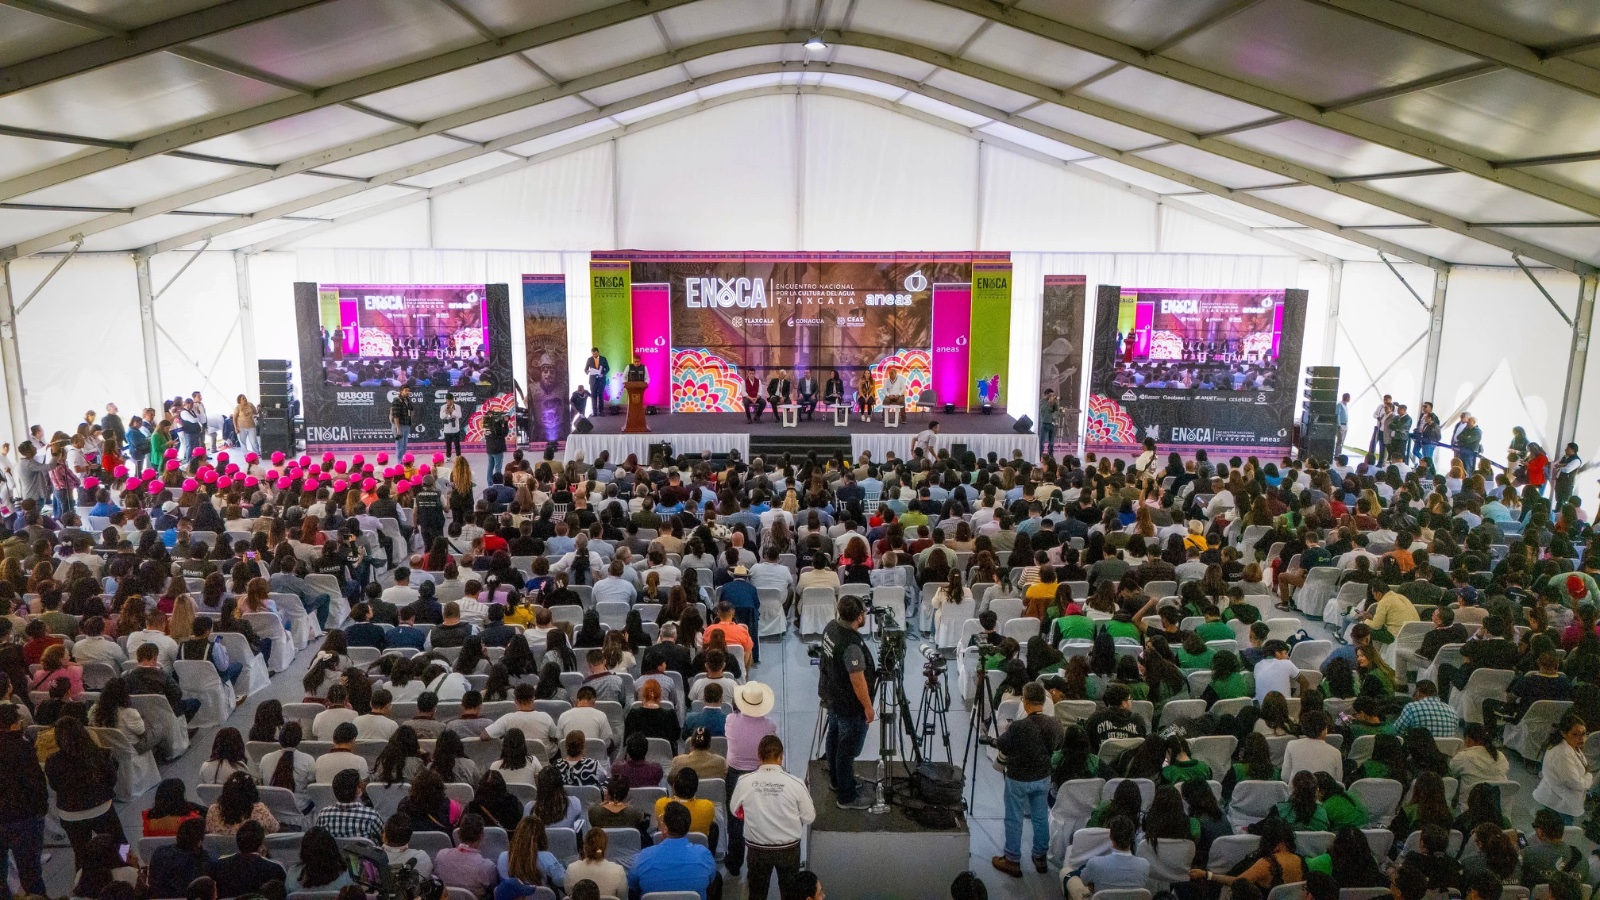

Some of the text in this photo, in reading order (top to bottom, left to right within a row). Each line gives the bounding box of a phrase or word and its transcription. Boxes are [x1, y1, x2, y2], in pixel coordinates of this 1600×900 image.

[776, 297, 855, 305] TLAXCALA
[865, 293, 913, 306] aneas
[336, 391, 375, 399] NABOHI
